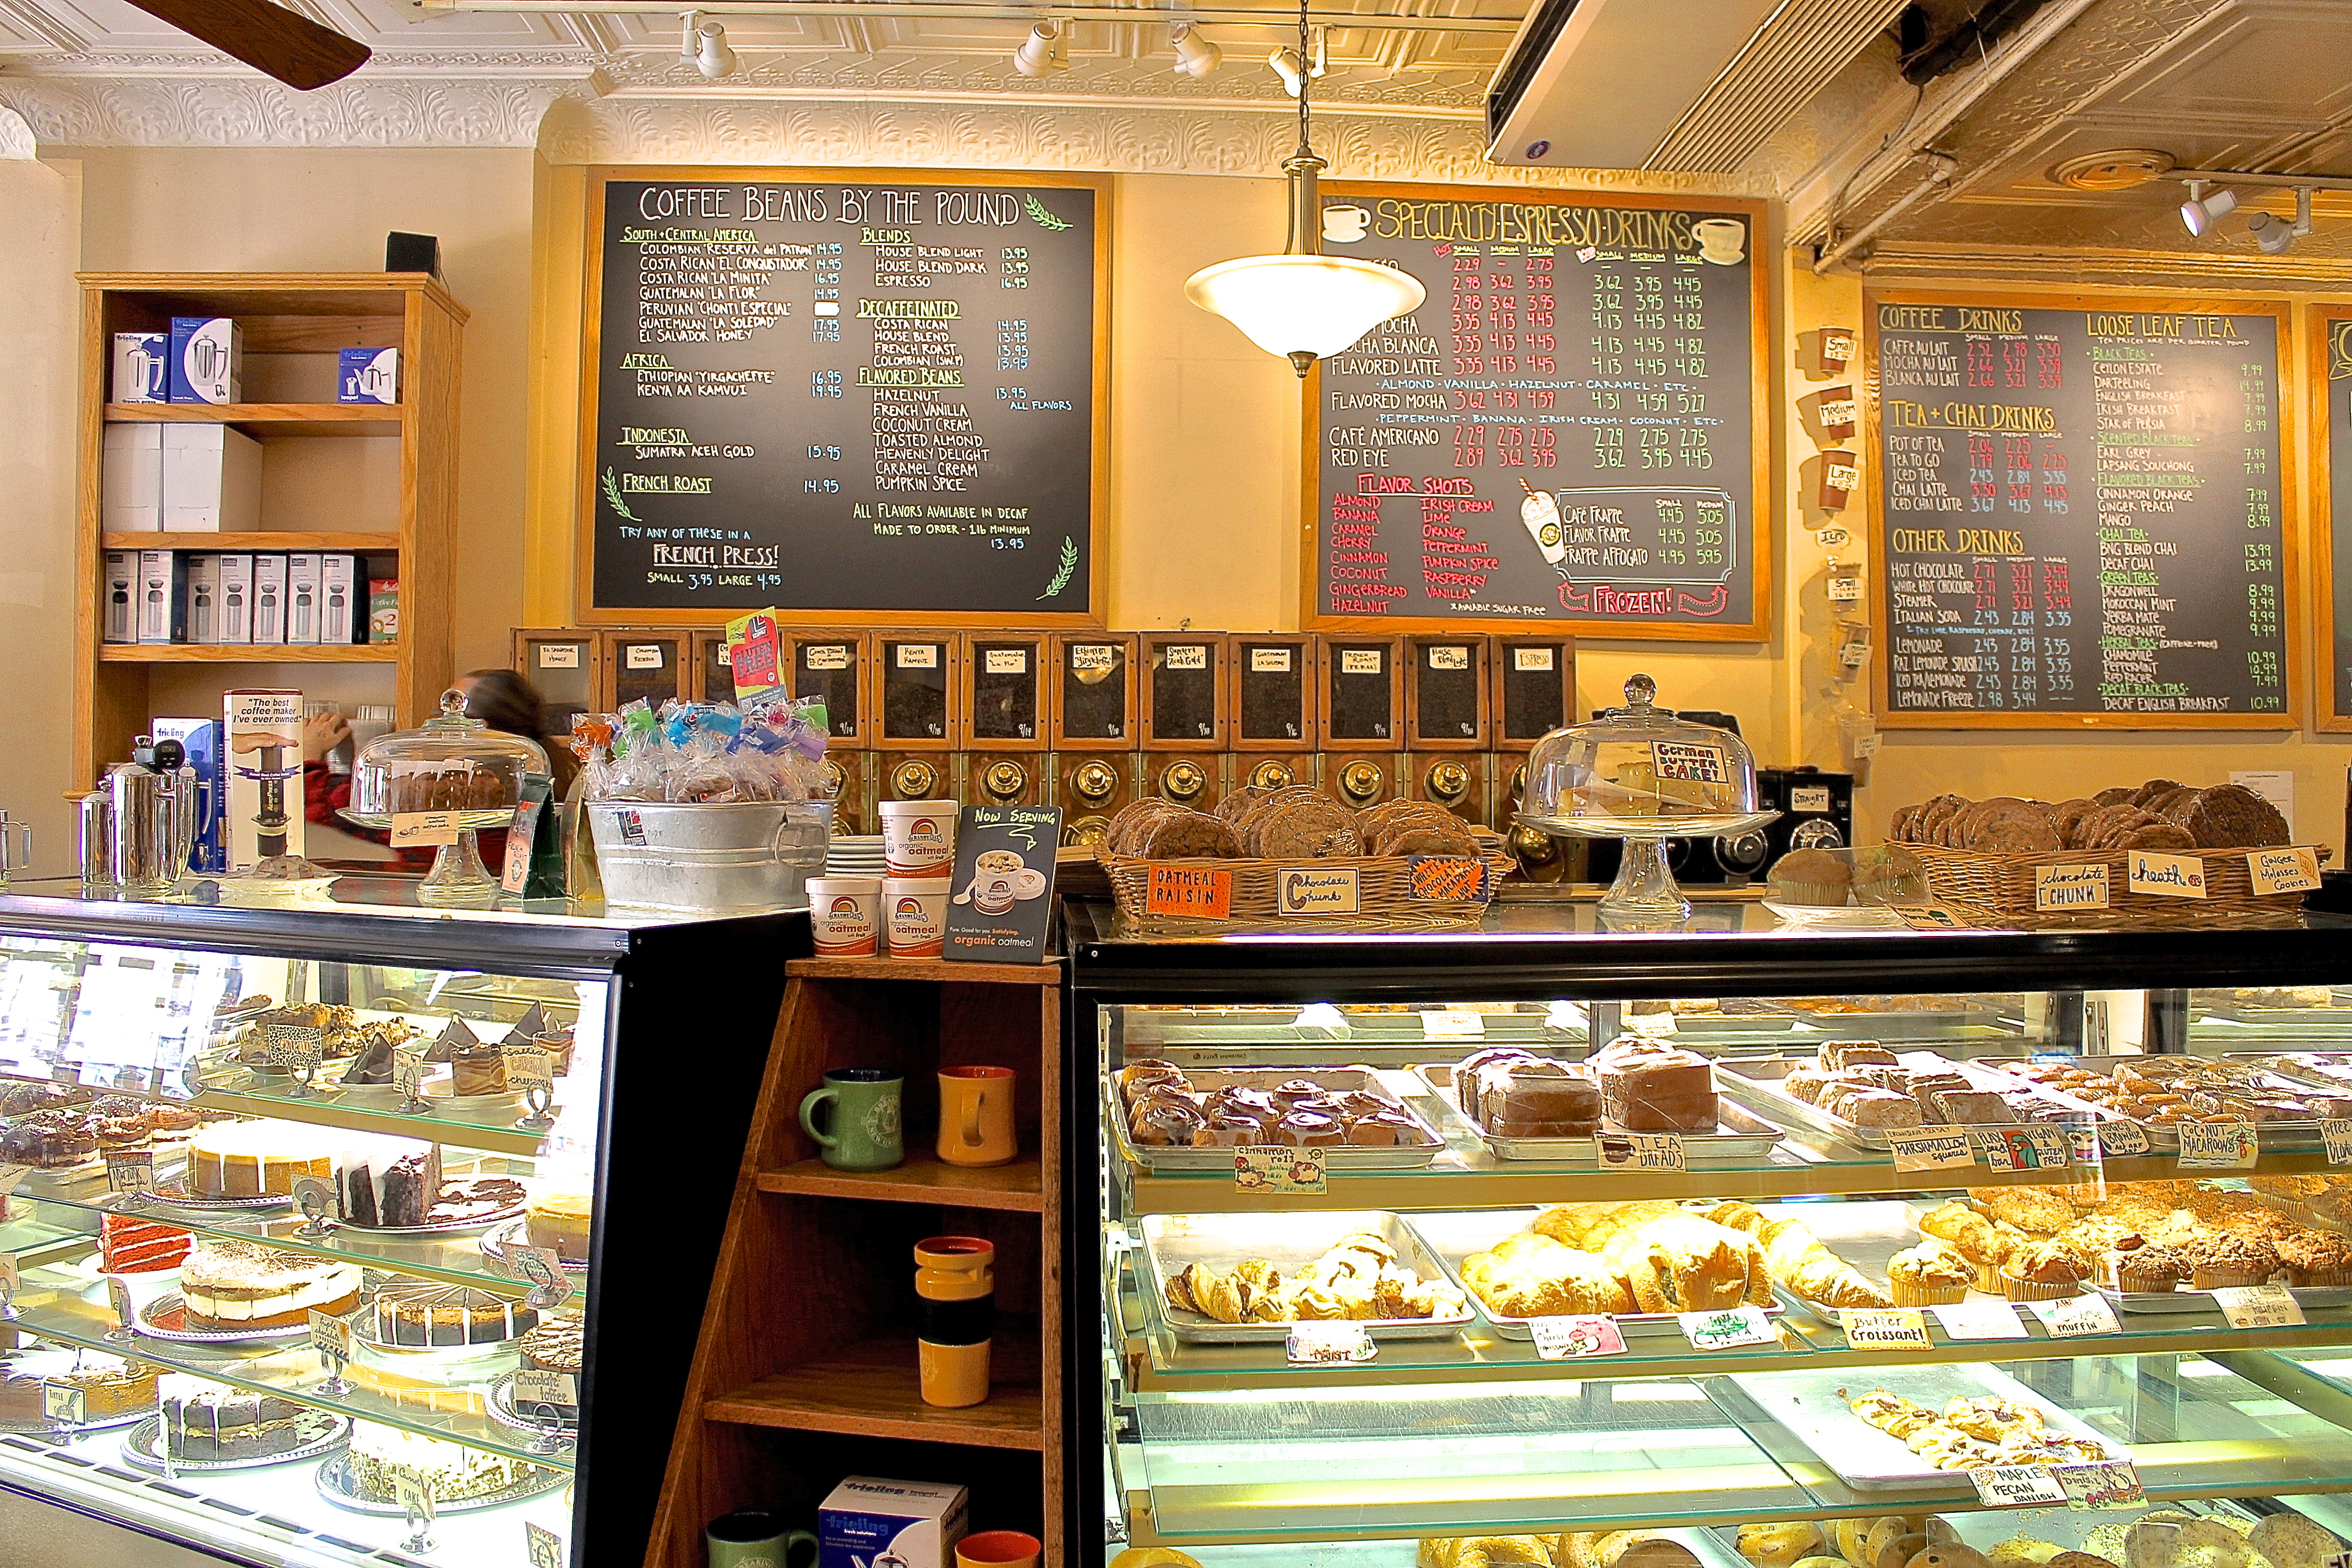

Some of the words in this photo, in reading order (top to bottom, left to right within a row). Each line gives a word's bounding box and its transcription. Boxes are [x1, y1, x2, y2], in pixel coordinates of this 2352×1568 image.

[640, 187, 731, 221] COFFEE
[742, 187, 827, 221] BEANS
[836, 189, 872, 224] BY
[881, 190, 922, 224] THE
[935, 192, 1020, 227] POUND
[876, 247, 912, 258] HOUSE
[918, 247, 951, 257] BLEND
[955, 248, 983, 258] LIGHT
[1002, 248, 1028, 259] 13.95
[859, 300, 959, 317] DECAFFEINATED
[1880, 307, 1946, 330] COFFEE
[1959, 309, 2022, 331] DRINKS
[2087, 314, 2135, 337] LOOSE
[2141, 315, 2186, 337] LEAF
[2192, 317, 2236, 338] TEA
[640, 331, 651, 342] EL
[657, 330, 709, 342] SALVADOR
[716, 329, 753, 340] HONEY
[813, 331, 840, 342] 17.95
[1828, 338, 1854, 351] Small
[623, 353, 668, 367] AFRICA
[1332, 357, 1400, 376] FLAVORED
[1404, 359, 1443, 376] LATTE
[1453, 357, 1484, 375] 3.35
[1490, 356, 1517, 373] 4.13
[1526, 355, 1556, 373] 4.45
[1591, 358, 1623, 375] 4.13
[1635, 358, 1667, 375] 4.45
[1675, 358, 1709, 378] 4.82
[638, 384, 672, 397] KENYA
[677, 385, 692, 396] AA
[698, 385, 747, 396] KAMVUI
[812, 385, 842, 398] 19.95
[1821, 404, 1855, 417] Medium
[1888, 400, 1927, 428] TEA
[1931, 408, 1941, 418] +
[1944, 401, 1986, 427] CHAI
[1991, 404, 2055, 431] DRINKS
[636, 446, 685, 459] SUMATRA
[692, 446, 718, 458] ACEH
[723, 446, 755, 458] GOLD
[808, 446, 841, 461] 15.95
[1831, 466, 1856, 481] Large
[623, 473, 668, 492] FRENCH
[674, 476, 712, 492] ROAST
[804, 480, 840, 493] 14.95
[875, 477, 927, 492] PUMPKIN
[933, 476, 966, 491] SPICE
[1358, 474, 1416, 493] FLAVOR
[1423, 477, 1474, 494] SHOTS
[853, 503, 872, 519] ALL
[879, 503, 922, 518] FLAVORS
[927, 505, 977, 519] AVAILABLE
[981, 507, 993, 518] IN
[997, 508, 1028, 519] DECAF
[2247, 515, 2271, 529] 8.99
[1892, 528, 1951, 552] OTHER
[1958, 529, 2024, 553] DRINKS
[653, 544, 715, 564] FRENCH
[723, 545, 779, 565] PRESS!
[647, 572, 684, 584] SMALL
[688, 574, 712, 590] 3.95
[718, 575, 753, 586] LARGE
[758, 574, 782, 591] 4.95
[1836, 579, 1855, 587] Small
[1593, 584, 1673, 614] FROZEN!
[1660, 757, 1719, 769] BUTTER
[1664, 765, 1718, 781] CAKE!
[908, 845, 948, 854] oatmeal
[1158, 870, 1216, 886] OATMEAL
[1413, 862, 1440, 885] WHITE
[1418, 862, 1460, 896] CHOCOLATE
[2041, 867, 2105, 885] chocolate
[2132, 859, 2186, 886] heath
[1156, 888, 1213, 904] RAISIN
[1458, 880, 1471, 897] NUT
[829, 922, 871, 933] oatmeal
[896, 924, 938, 933] oatmeal
[955, 935, 995, 947] organic
[998, 937, 1034, 947] oatmeal
[2024, 1128, 2056, 1140] VEGAN
[1635, 1136, 1681, 1150] TEA
[1897, 1136, 1967, 1156] MARSHMALLOW
[2037, 1146, 2064, 1156] GLUTEN
[2182, 1137, 2235, 1154] MACAROONS
[1640, 1150, 1683, 1168] BREADS
[1991, 1156, 2012, 1166] bar
[2044, 1156, 2064, 1166] FREE
[1853, 1317, 1903, 1330] Butter
[1851, 1328, 1926, 1345] Croissant!
[1996, 1467, 2045, 1482] MAPLE
[1993, 1482, 2035, 1495] PECAN
[2014, 1493, 2057, 1502] DANISH
